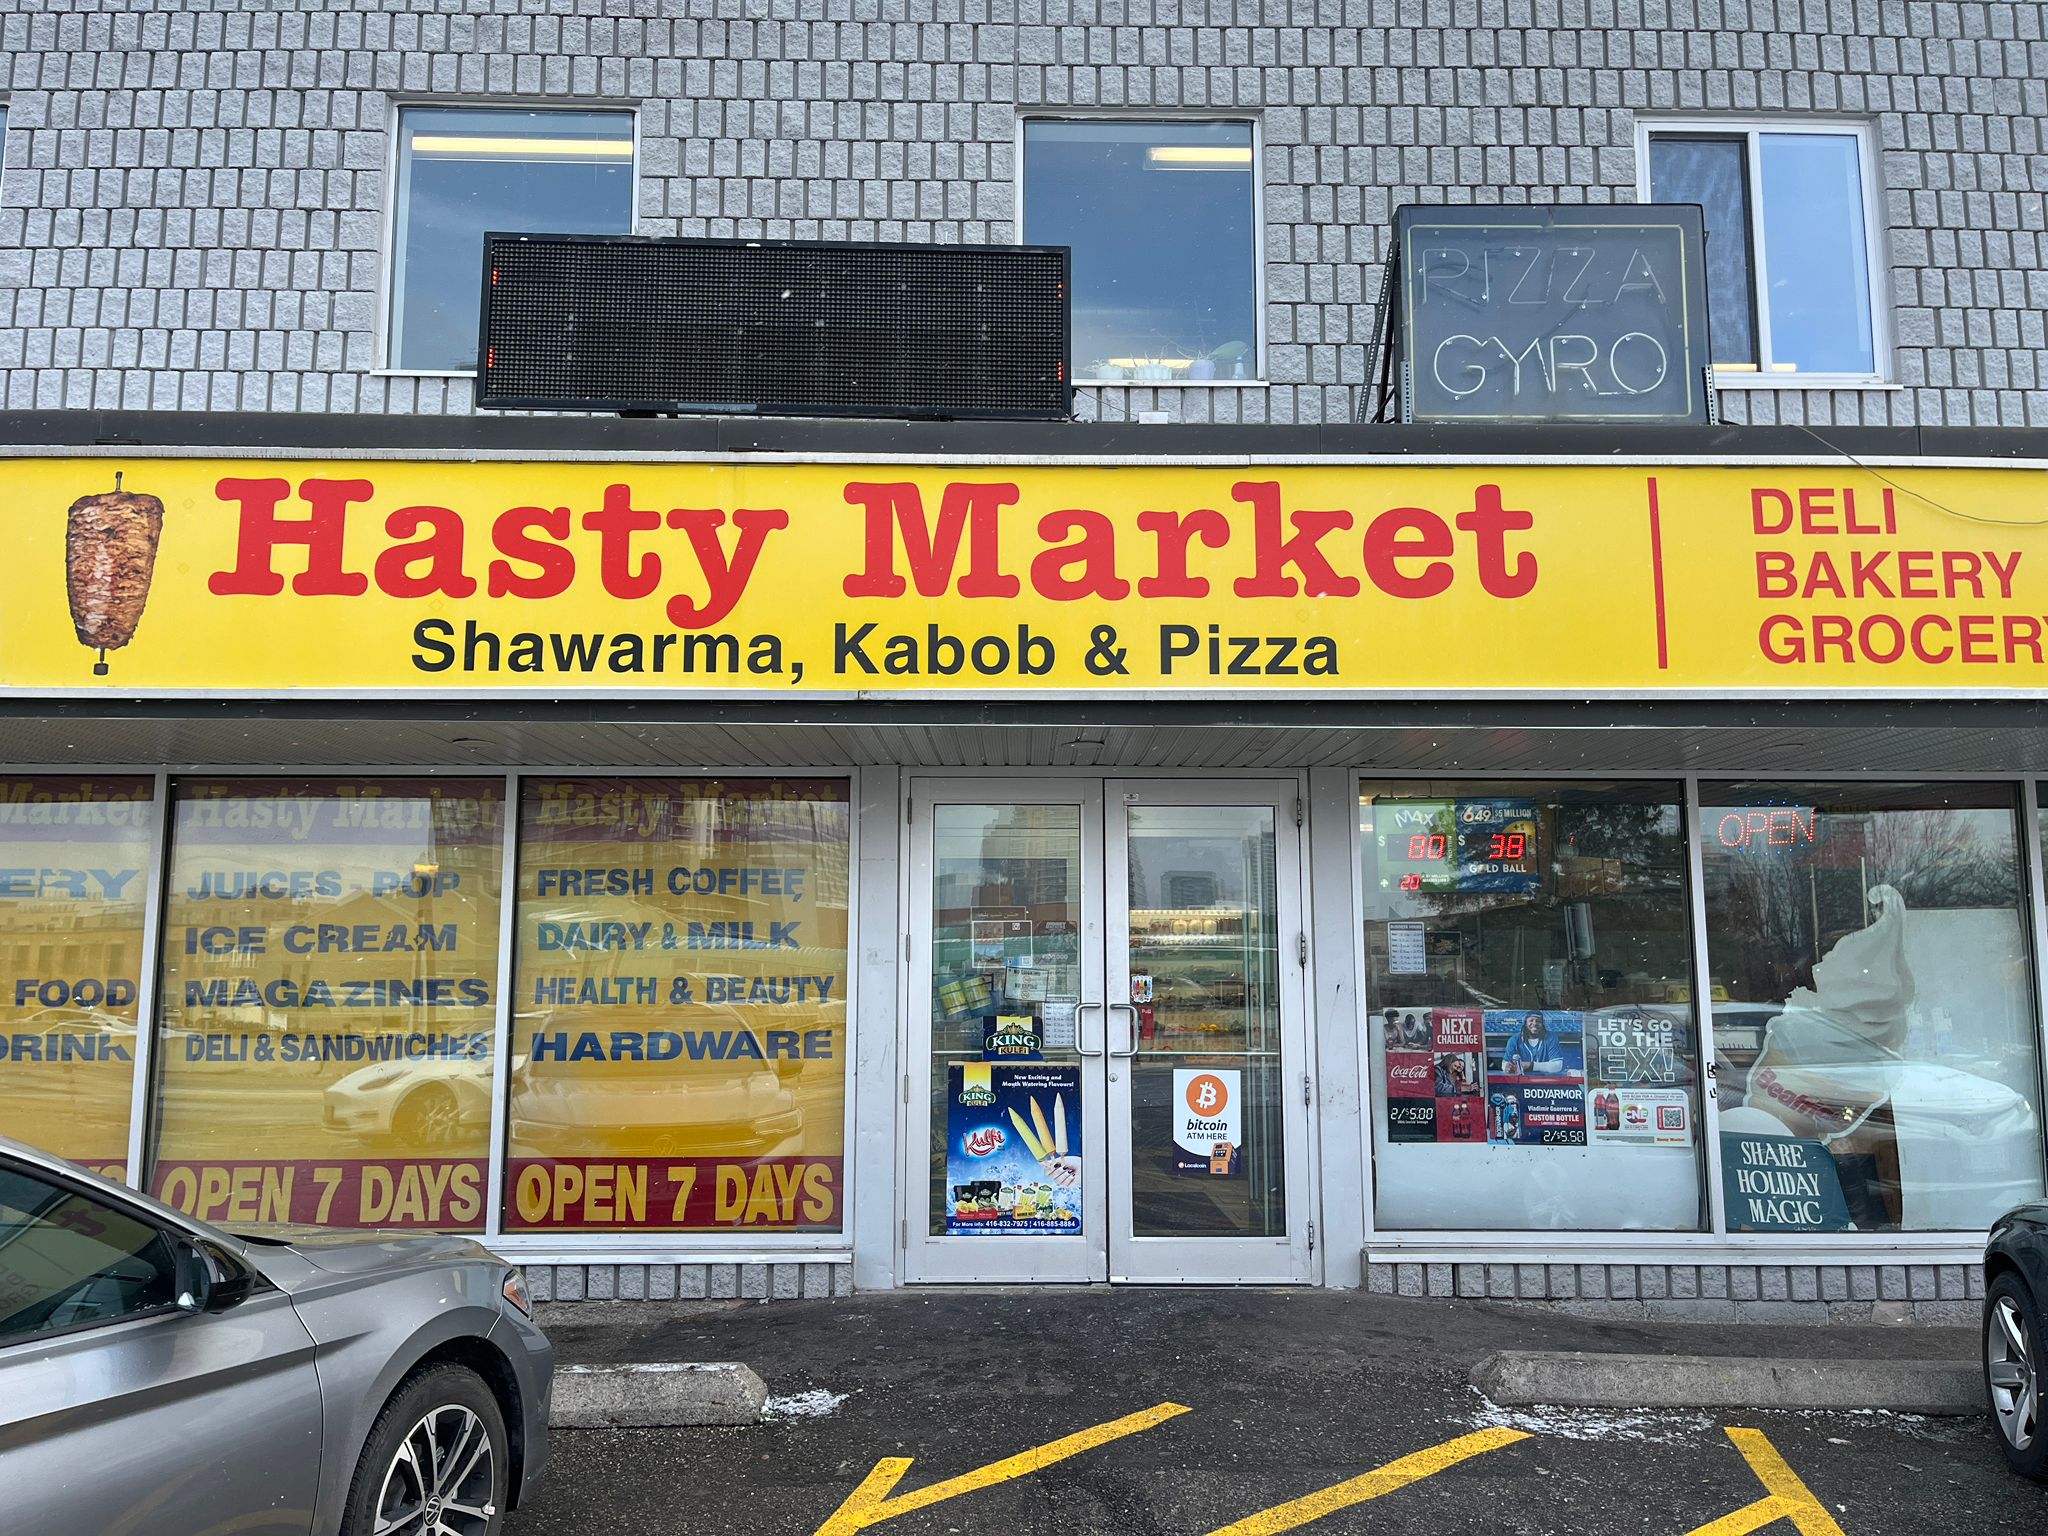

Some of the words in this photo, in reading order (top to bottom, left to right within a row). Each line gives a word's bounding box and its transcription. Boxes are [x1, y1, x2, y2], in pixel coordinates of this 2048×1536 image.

[1421, 247, 1667, 305] PIZZA
[1433, 333, 1667, 396] GYRO
[1752, 488, 1897, 535] DELI
[208, 478, 789, 629] Hasty
[842, 481, 1538, 601] Market
[1756, 551, 2021, 598] BAKERY
[411, 619, 804, 685] Shawarma,
[833, 622, 1057, 676] Kabob
[1083, 625, 1129, 676] &
[1160, 624, 1339, 676] Pizza
[1759, 614, 2048, 664] GROCER
[187, 785, 320, 840] Hasty
[332, 785, 498, 830] Market
[536, 784, 668, 837] Hasty
[678, 784, 838, 828] Market
[1394, 808, 1434, 828] MAX
[1504, 808, 1532, 818] MILLION
[1718, 808, 1815, 848] OPEN
[1378, 835, 1385, 847] $
[1408, 835, 1445, 860] 80
[1458, 835, 1466, 846] $
[1489, 834, 1526, 860] 38
[537, 868, 653, 897] FRESH
[1400, 874, 1421, 891] 20
[1503, 864, 1527, 873] BALL
[187, 871, 342, 899] JUICES
[373, 870, 461, 898] POP
[185, 927, 267, 955] ICE
[283, 924, 457, 955] CREAM
[537, 922, 652, 951] DAIRY
[661, 922, 679, 950] &
[687, 921, 802, 951] MILK
[15, 979, 137, 1008] FOOD
[185, 979, 489, 1008] MAGAZINES
[534, 977, 656, 1005] HEALTH
[669, 976, 693, 1004] &
[706, 975, 835, 1005] BEAUTY
[992, 1032, 1036, 1048] KING
[1437, 1035, 1479, 1045] CHALLENGE
[1441, 1018, 1473, 1034] NEXT
[1598, 1018, 1643, 1033] LET'S
[1647, 1020, 1673, 1033] GO
[1599, 1033, 1627, 1047] TO
[1633, 1033, 1673, 1047] THE
[0, 1034, 132, 1062] RINK
[185, 1034, 247, 1062] DELI
[253, 1034, 275, 1062] &
[281, 1032, 488, 1062] SANDWICHES
[531, 1030, 833, 1062] HARDWARE
[998, 1046, 1029, 1055] KULFI
[1599, 1047, 1676, 1082] EX!
[963, 1092, 992, 1102] KING
[1523, 1088, 1583, 1100] BODYARMOR
[1187, 1119, 1228, 1131] bitcoin
[1528, 1114, 1555, 1122] CUSTOM
[1556, 1114, 1580, 1122] BOTTLE
[1625, 1107, 1649, 1119] CNE
[962, 1127, 1005, 1157] Kulfi
[1740, 1140, 1806, 1168] SHARE
[160, 1165, 295, 1224] OPEN
[313, 1167, 343, 1224] 7
[359, 1164, 481, 1223] DAYS
[516, 1164, 648, 1223] OPEN
[667, 1166, 697, 1222] 7
[714, 1163, 834, 1222] DAYS
[1736, 1169, 1821, 1197] HOLIDAY
[985, 1220, 1028, 1228] 416-832-7975
[1748, 1198, 1823, 1225] MAGIC
